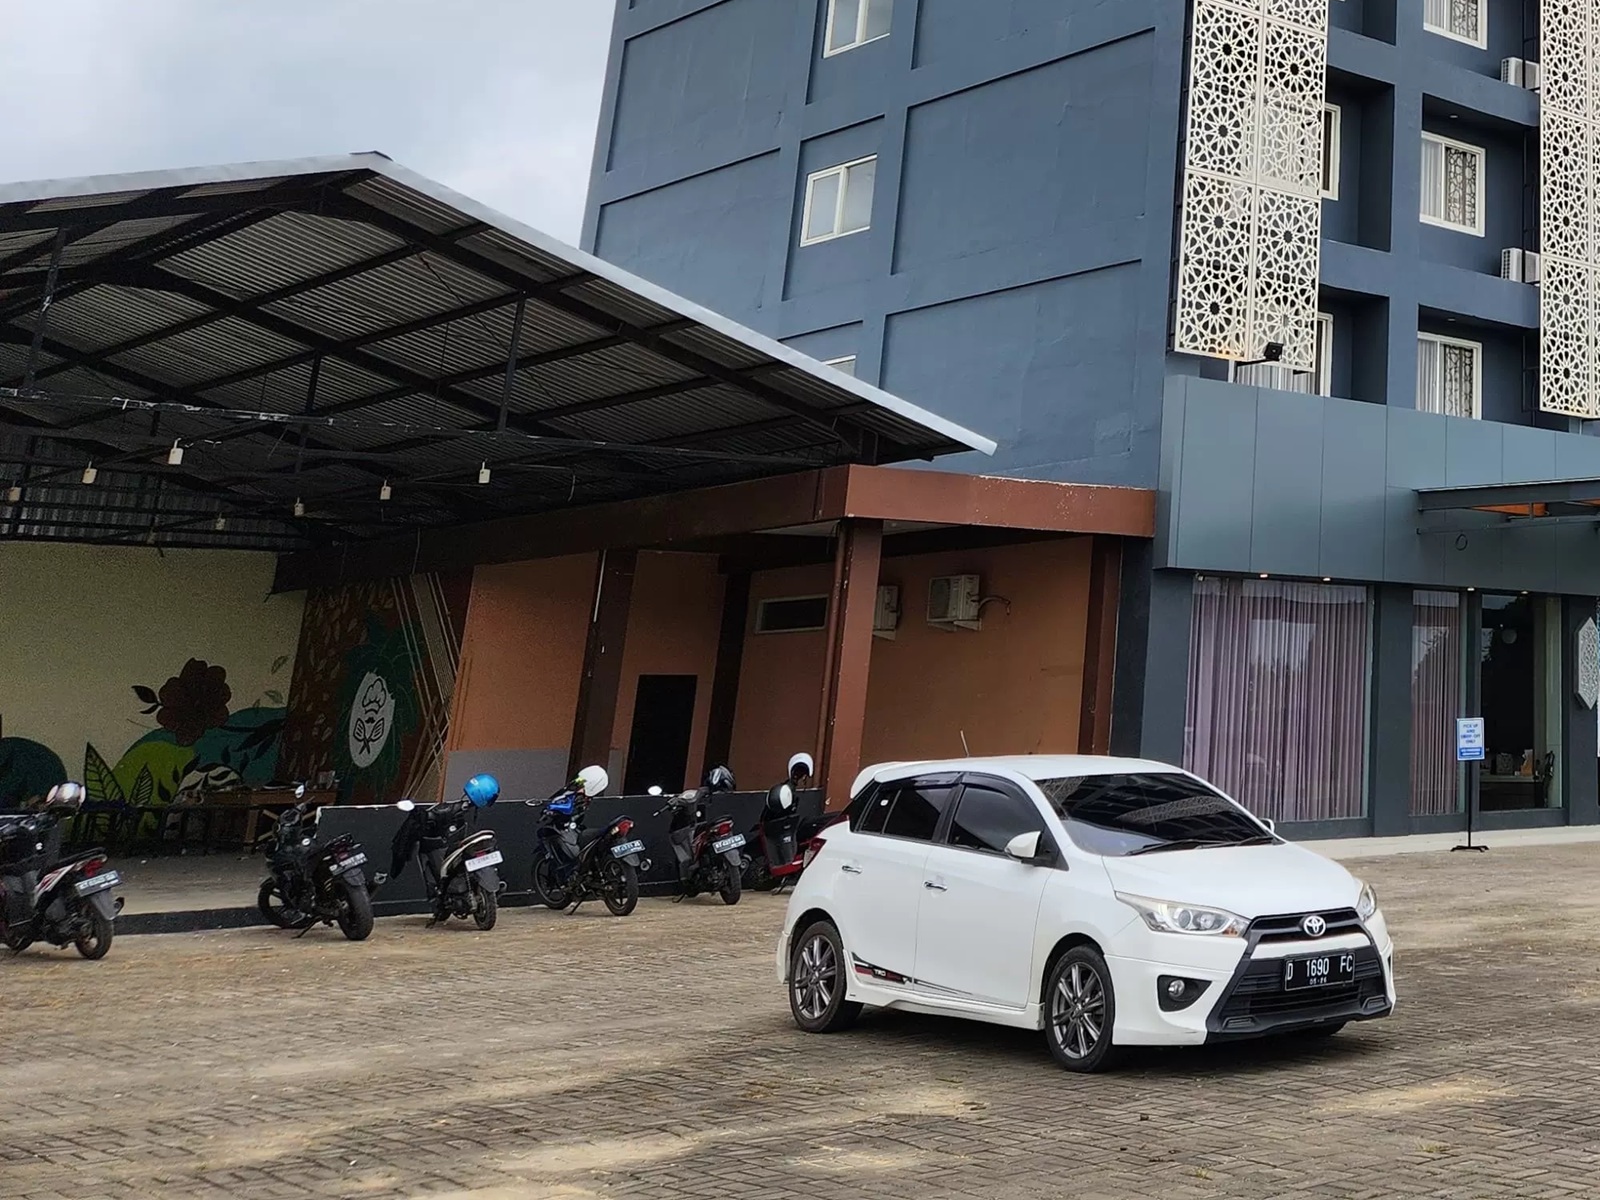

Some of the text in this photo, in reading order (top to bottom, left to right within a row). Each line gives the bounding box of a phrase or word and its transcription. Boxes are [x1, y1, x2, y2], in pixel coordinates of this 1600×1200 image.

[1287, 955, 1353, 980] D 1690 FC
